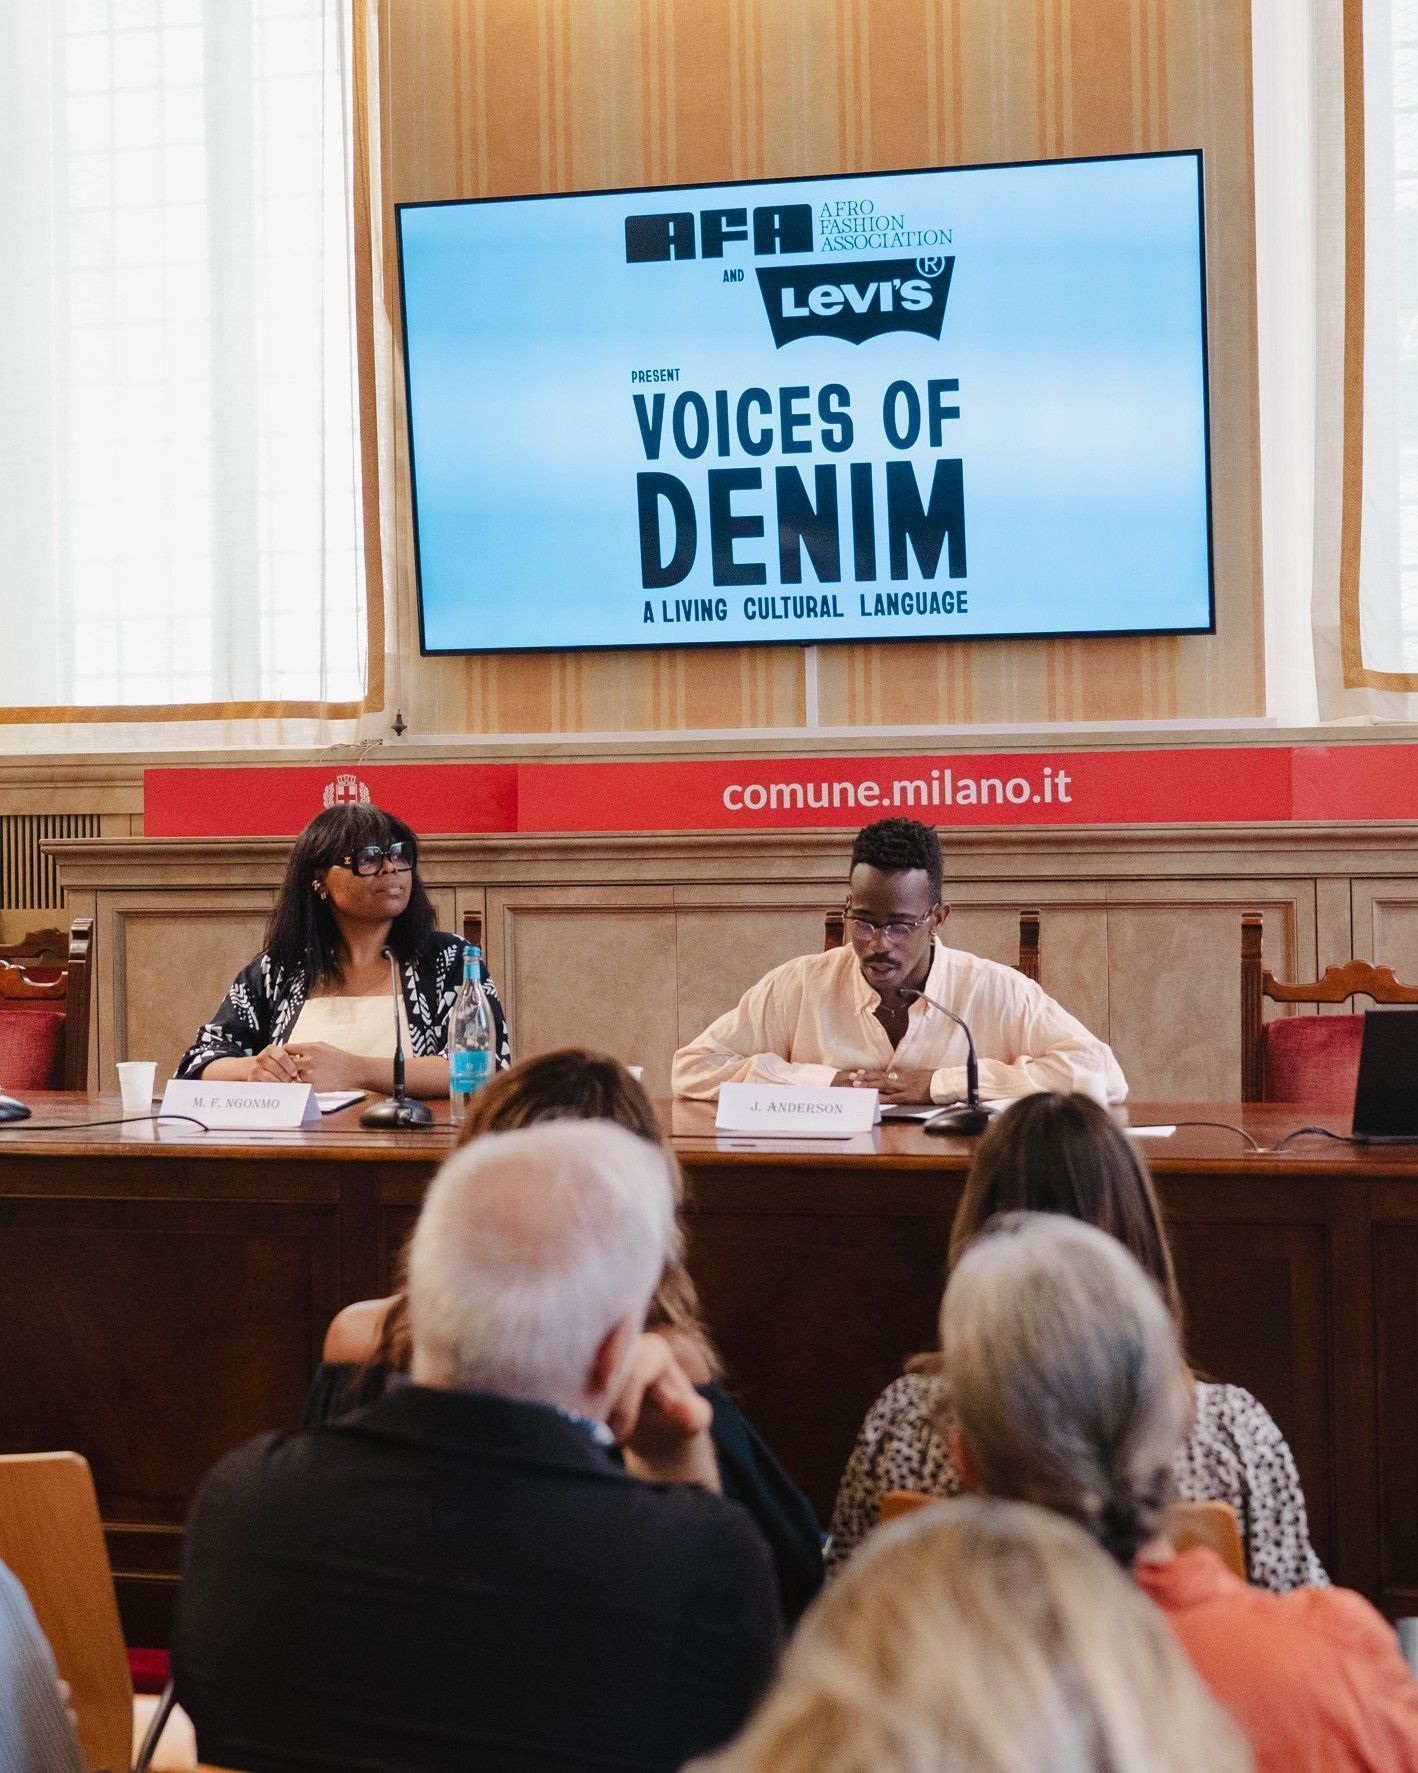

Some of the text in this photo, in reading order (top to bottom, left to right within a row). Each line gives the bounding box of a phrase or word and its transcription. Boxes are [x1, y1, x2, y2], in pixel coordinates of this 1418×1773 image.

[820, 200, 875, 217] AFRO
[625, 203, 814, 263] AFA
[820, 215, 905, 235] FASHION
[821, 229, 953, 252] ASSOCIATION
[722, 269, 745, 283] AND
[631, 368, 681, 383] PRESENT
[632, 378, 961, 460] VOICES OF
[636, 458, 968, 589] DENIM
[643, 591, 969, 623] A LIVING CULTURAL LANGUAGE
[722, 767, 1073, 811] comune.milano.it
[193, 1097, 280, 1109] M. F. NGONMO
[750, 1101, 843, 1114] J. ANDERSON
